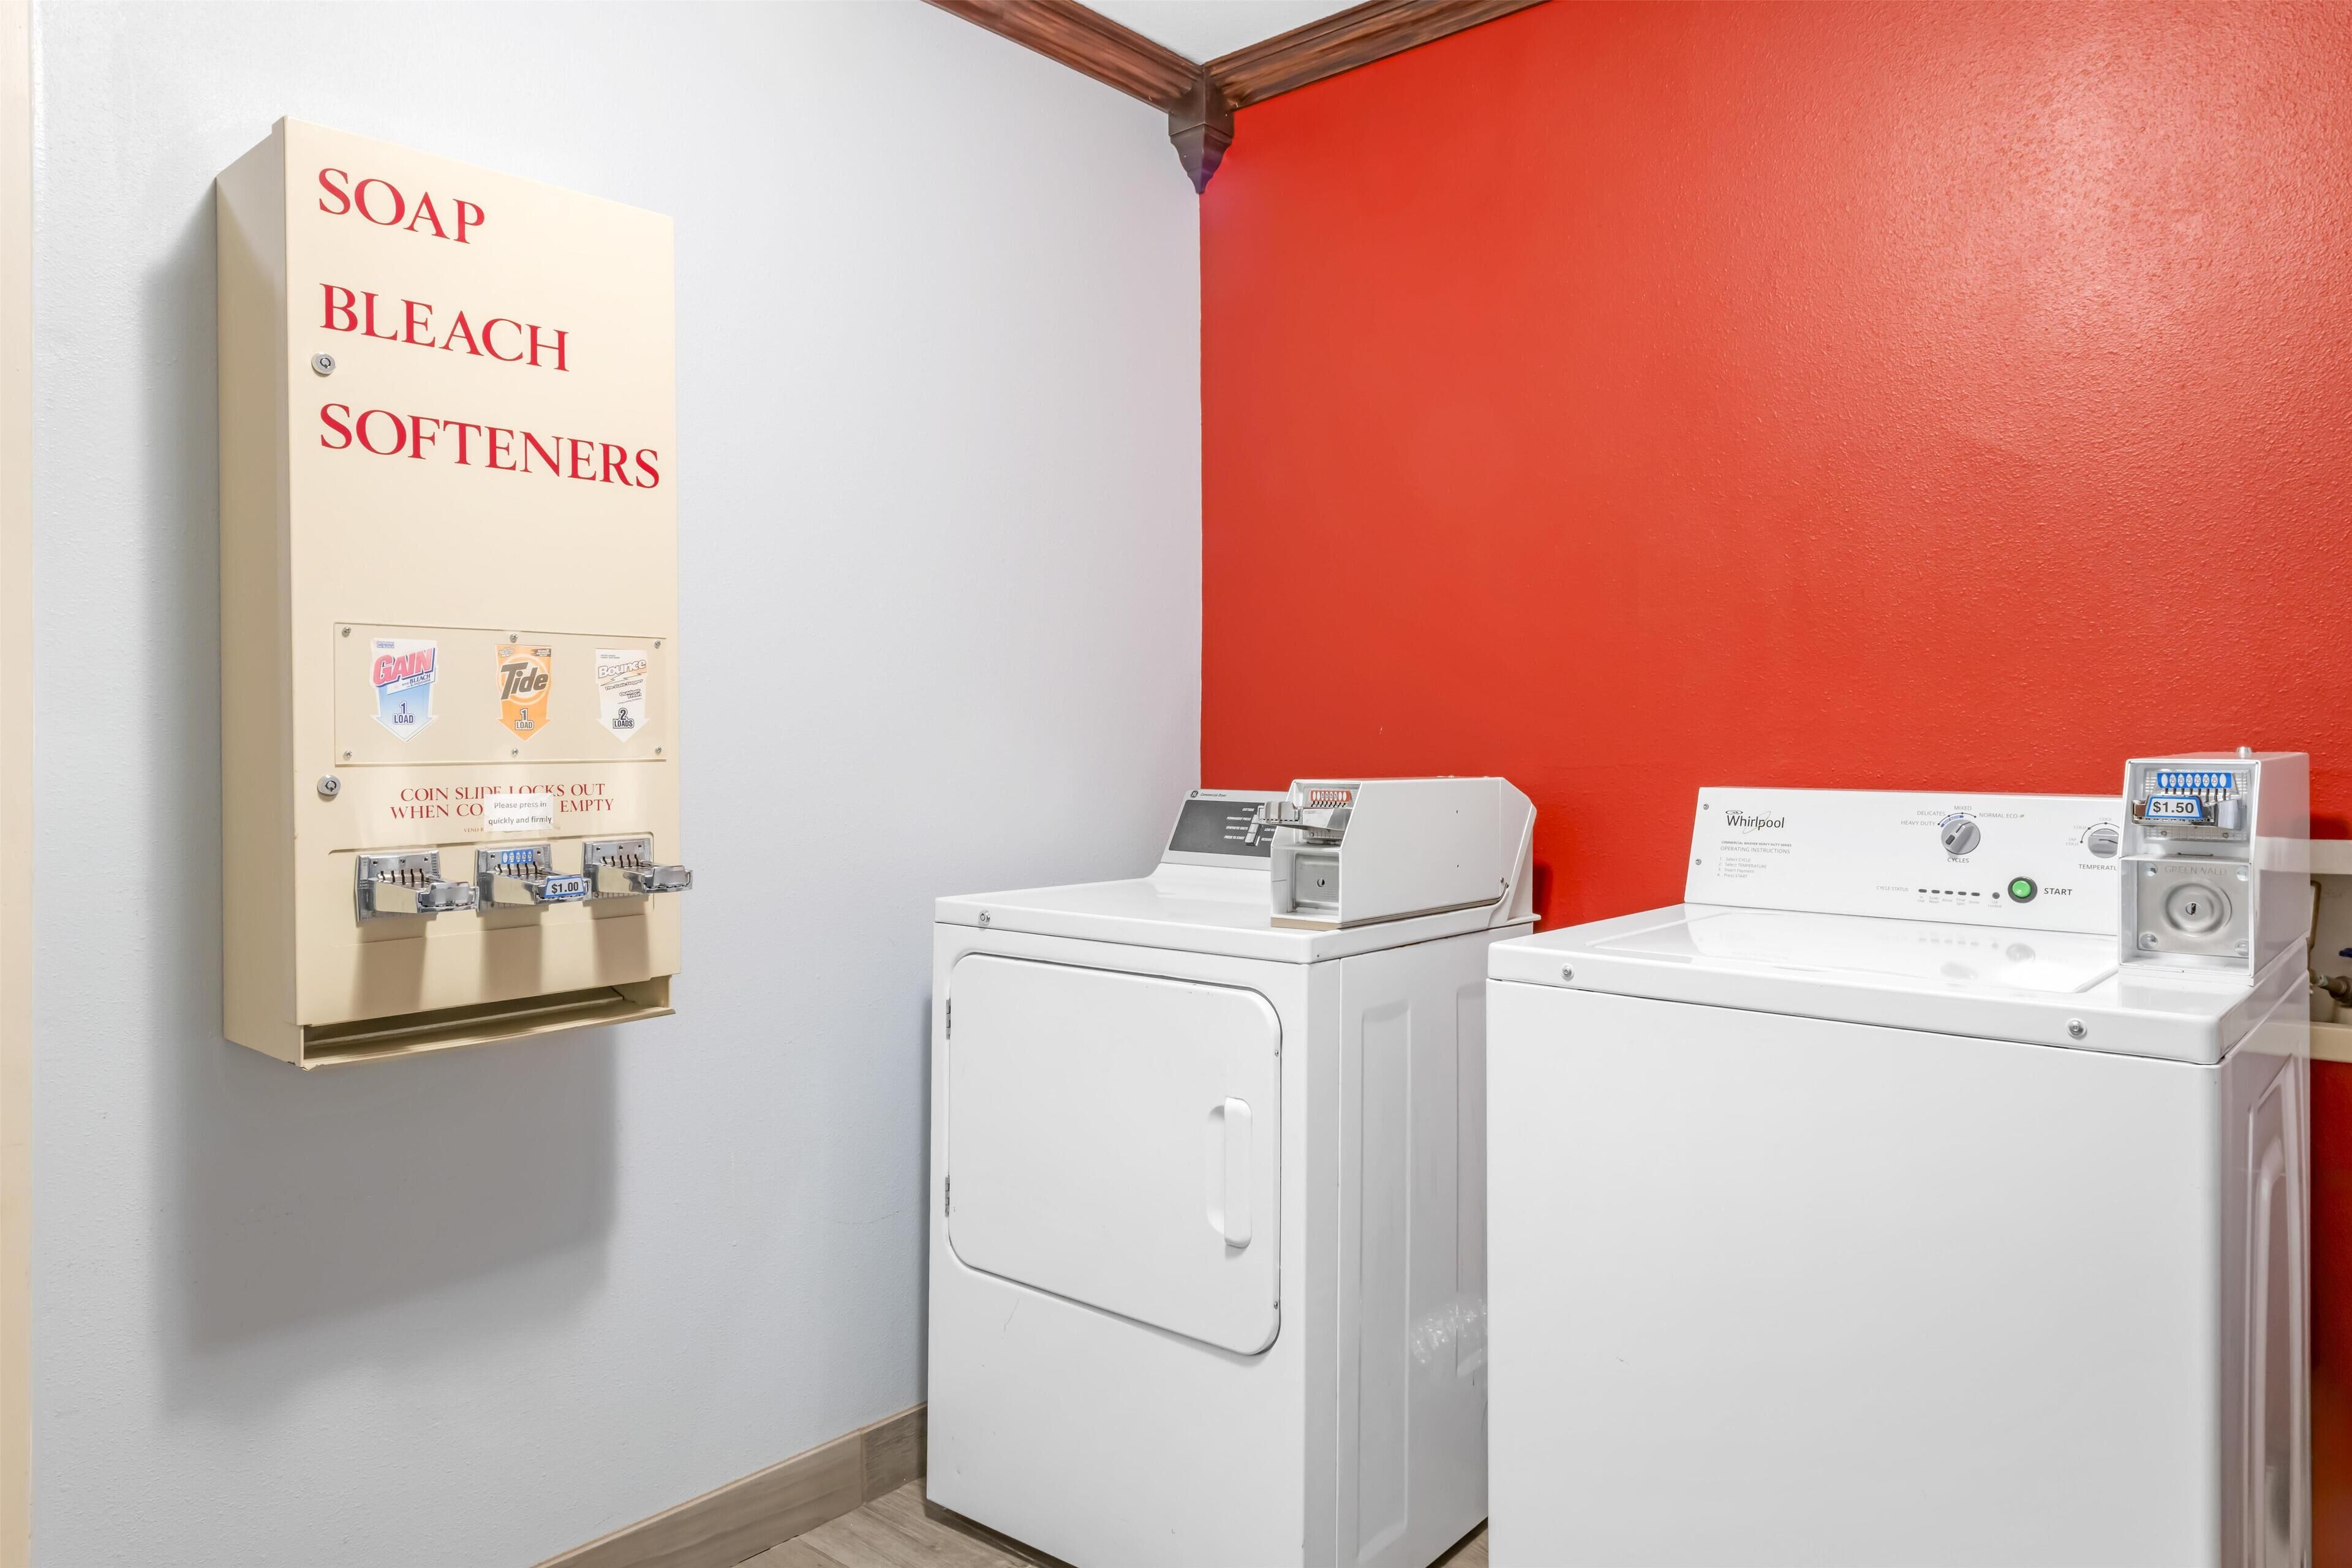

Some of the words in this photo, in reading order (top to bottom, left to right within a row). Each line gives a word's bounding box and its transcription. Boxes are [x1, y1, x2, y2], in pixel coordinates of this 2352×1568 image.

[318, 168, 484, 244] SOAP
[319, 283, 570, 372] BLEACH
[320, 403, 660, 489] SOFTENERS
[373, 647, 435, 687] GAIN
[598, 660, 646, 679] Bounce
[410, 674, 431, 684] BLEACH
[500, 662, 548, 700] Tide
[401, 702, 405, 714] 1
[521, 709, 527, 721] 1
[620, 709, 627, 720] 2
[394, 714, 413, 723] LOAD
[401, 787, 449, 801] COIN
[571, 783, 606, 796] OUT
[390, 804, 449, 819] WHEN
[560, 799, 614, 812] EMPTY
[2153, 801, 2194, 813] $1.50
[488, 817, 514, 826] quickly
[531, 815, 552, 824] firmly
[1727, 815, 1784, 831] Whirlpool
[551, 881, 579, 894] $1.00
